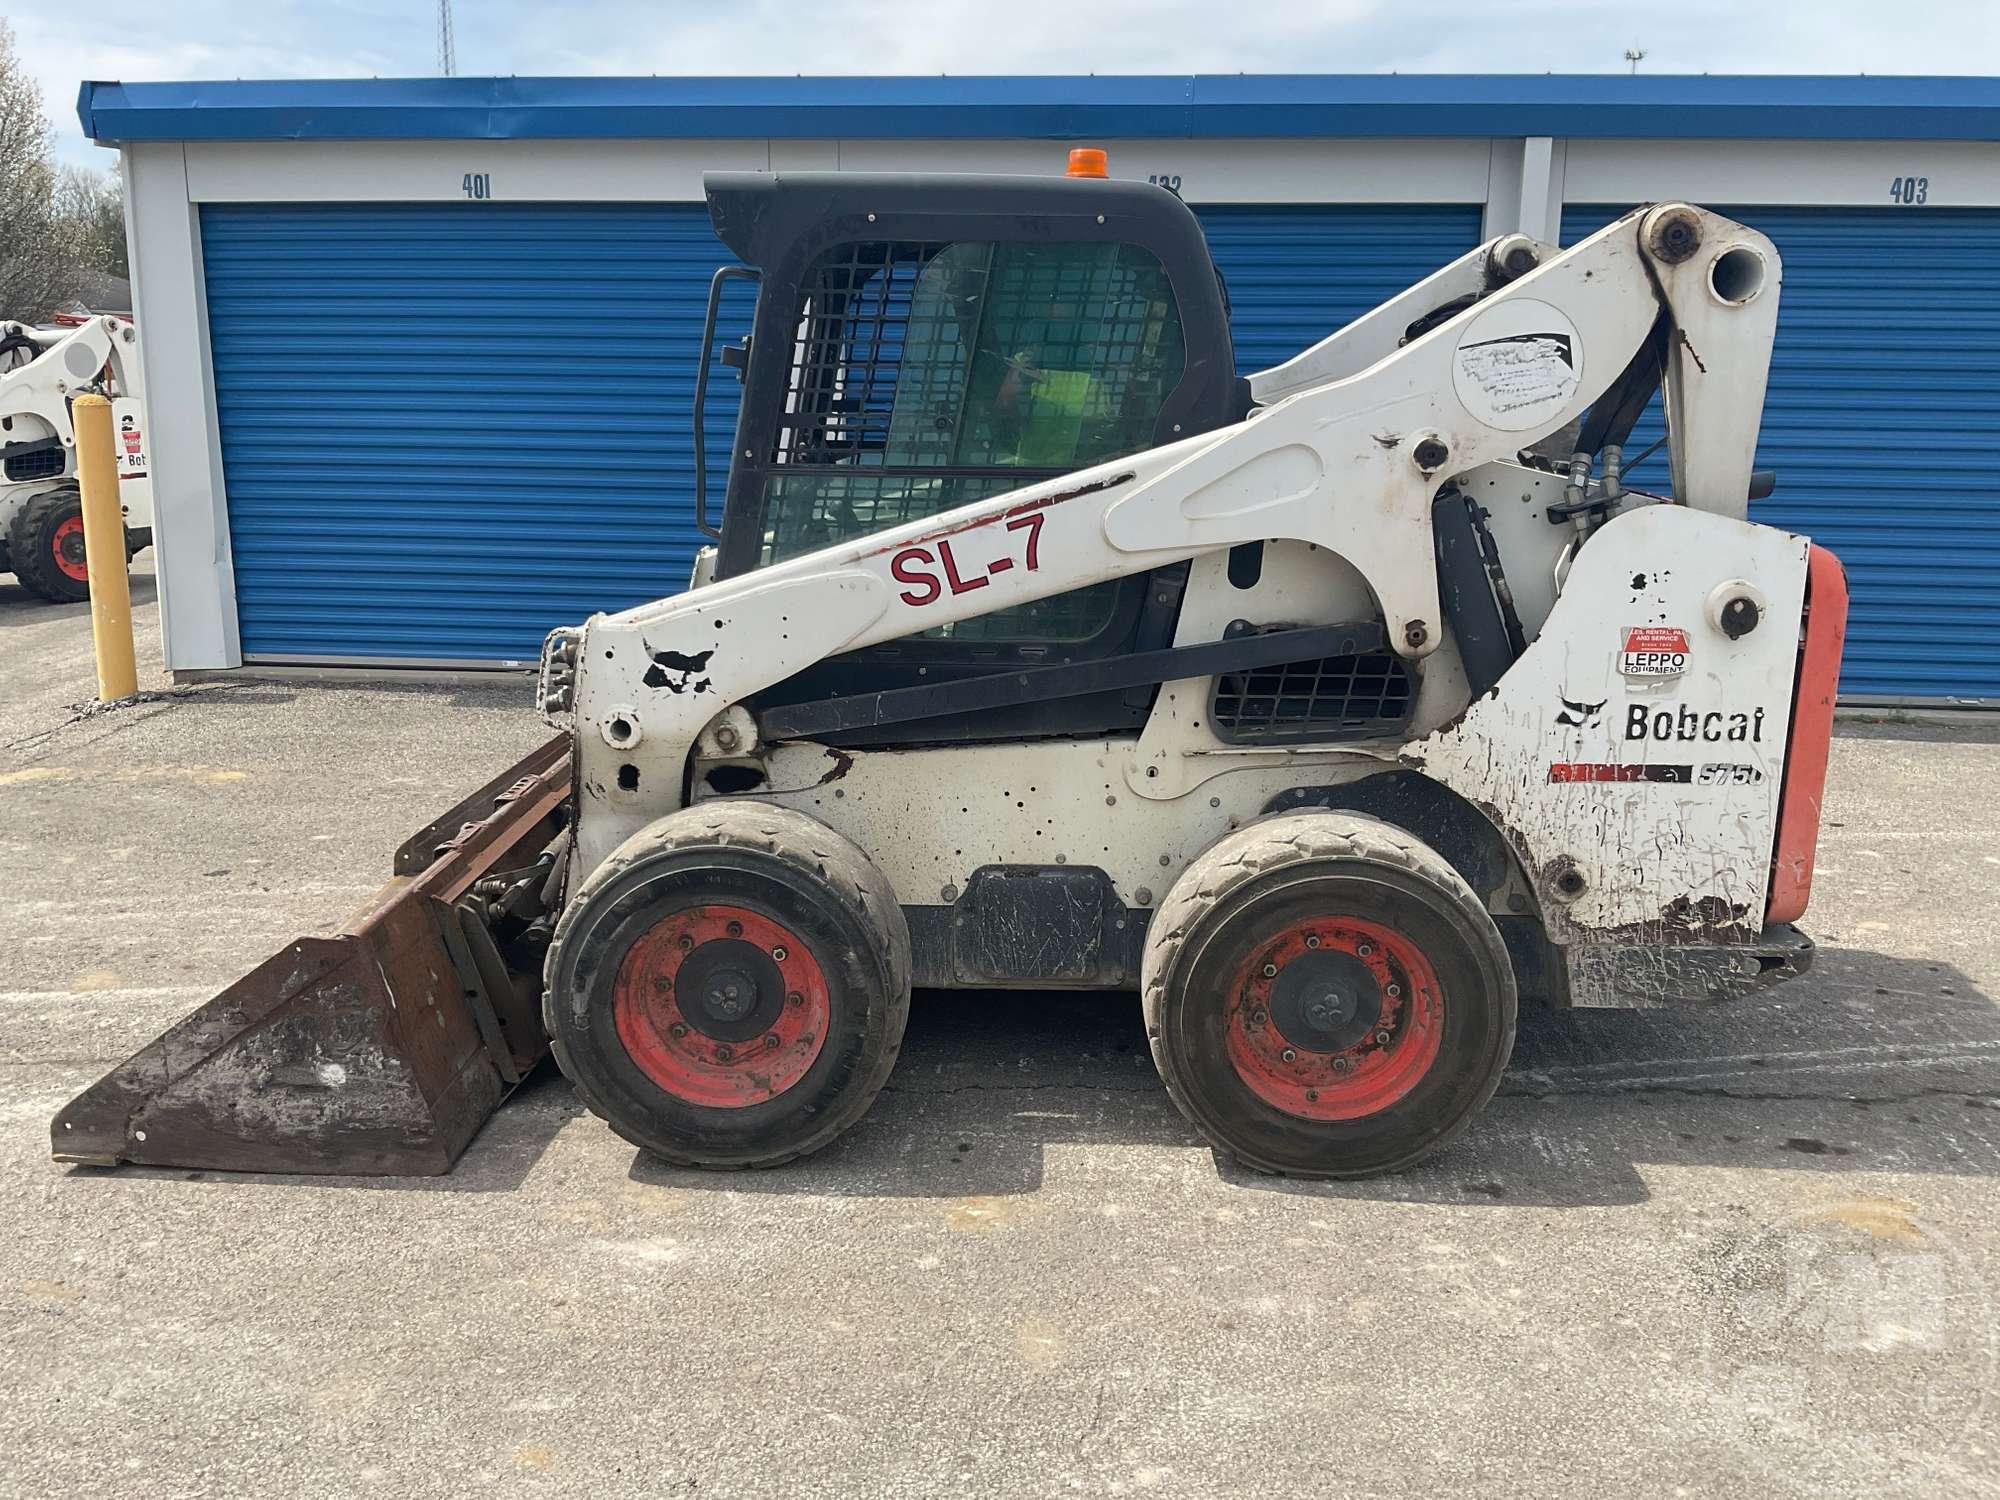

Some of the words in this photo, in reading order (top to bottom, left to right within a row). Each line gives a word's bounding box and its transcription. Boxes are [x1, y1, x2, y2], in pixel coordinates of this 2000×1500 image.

[463, 174, 490, 199] 401
[1890, 177, 1928, 204] 403
[891, 512, 1045, 606] SL-7
[1625, 653, 1684, 667] LEPPO
[1625, 703, 1765, 742] Bobcat
[1698, 763, 1766, 785] S750
